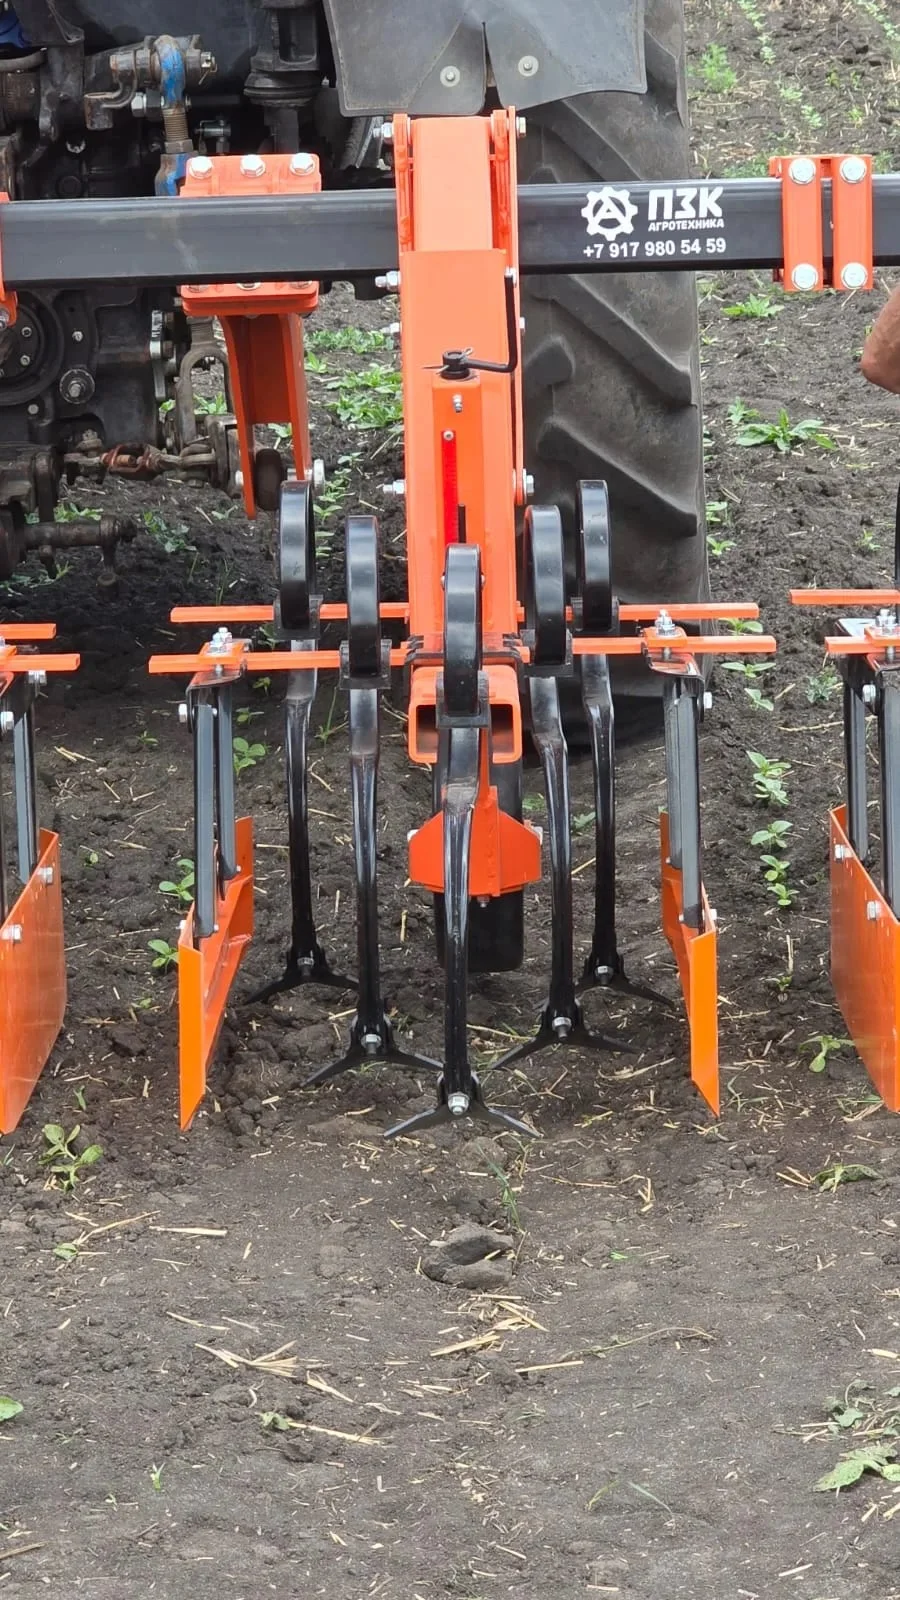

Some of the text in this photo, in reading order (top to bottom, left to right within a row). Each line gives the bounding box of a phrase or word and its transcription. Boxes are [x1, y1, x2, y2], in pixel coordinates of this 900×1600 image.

[648, 186, 724, 221] ПЗК
[648, 218, 725, 232] АГРОТЕХНИКА
[583, 237, 727, 259] +7 917 980 54 59
